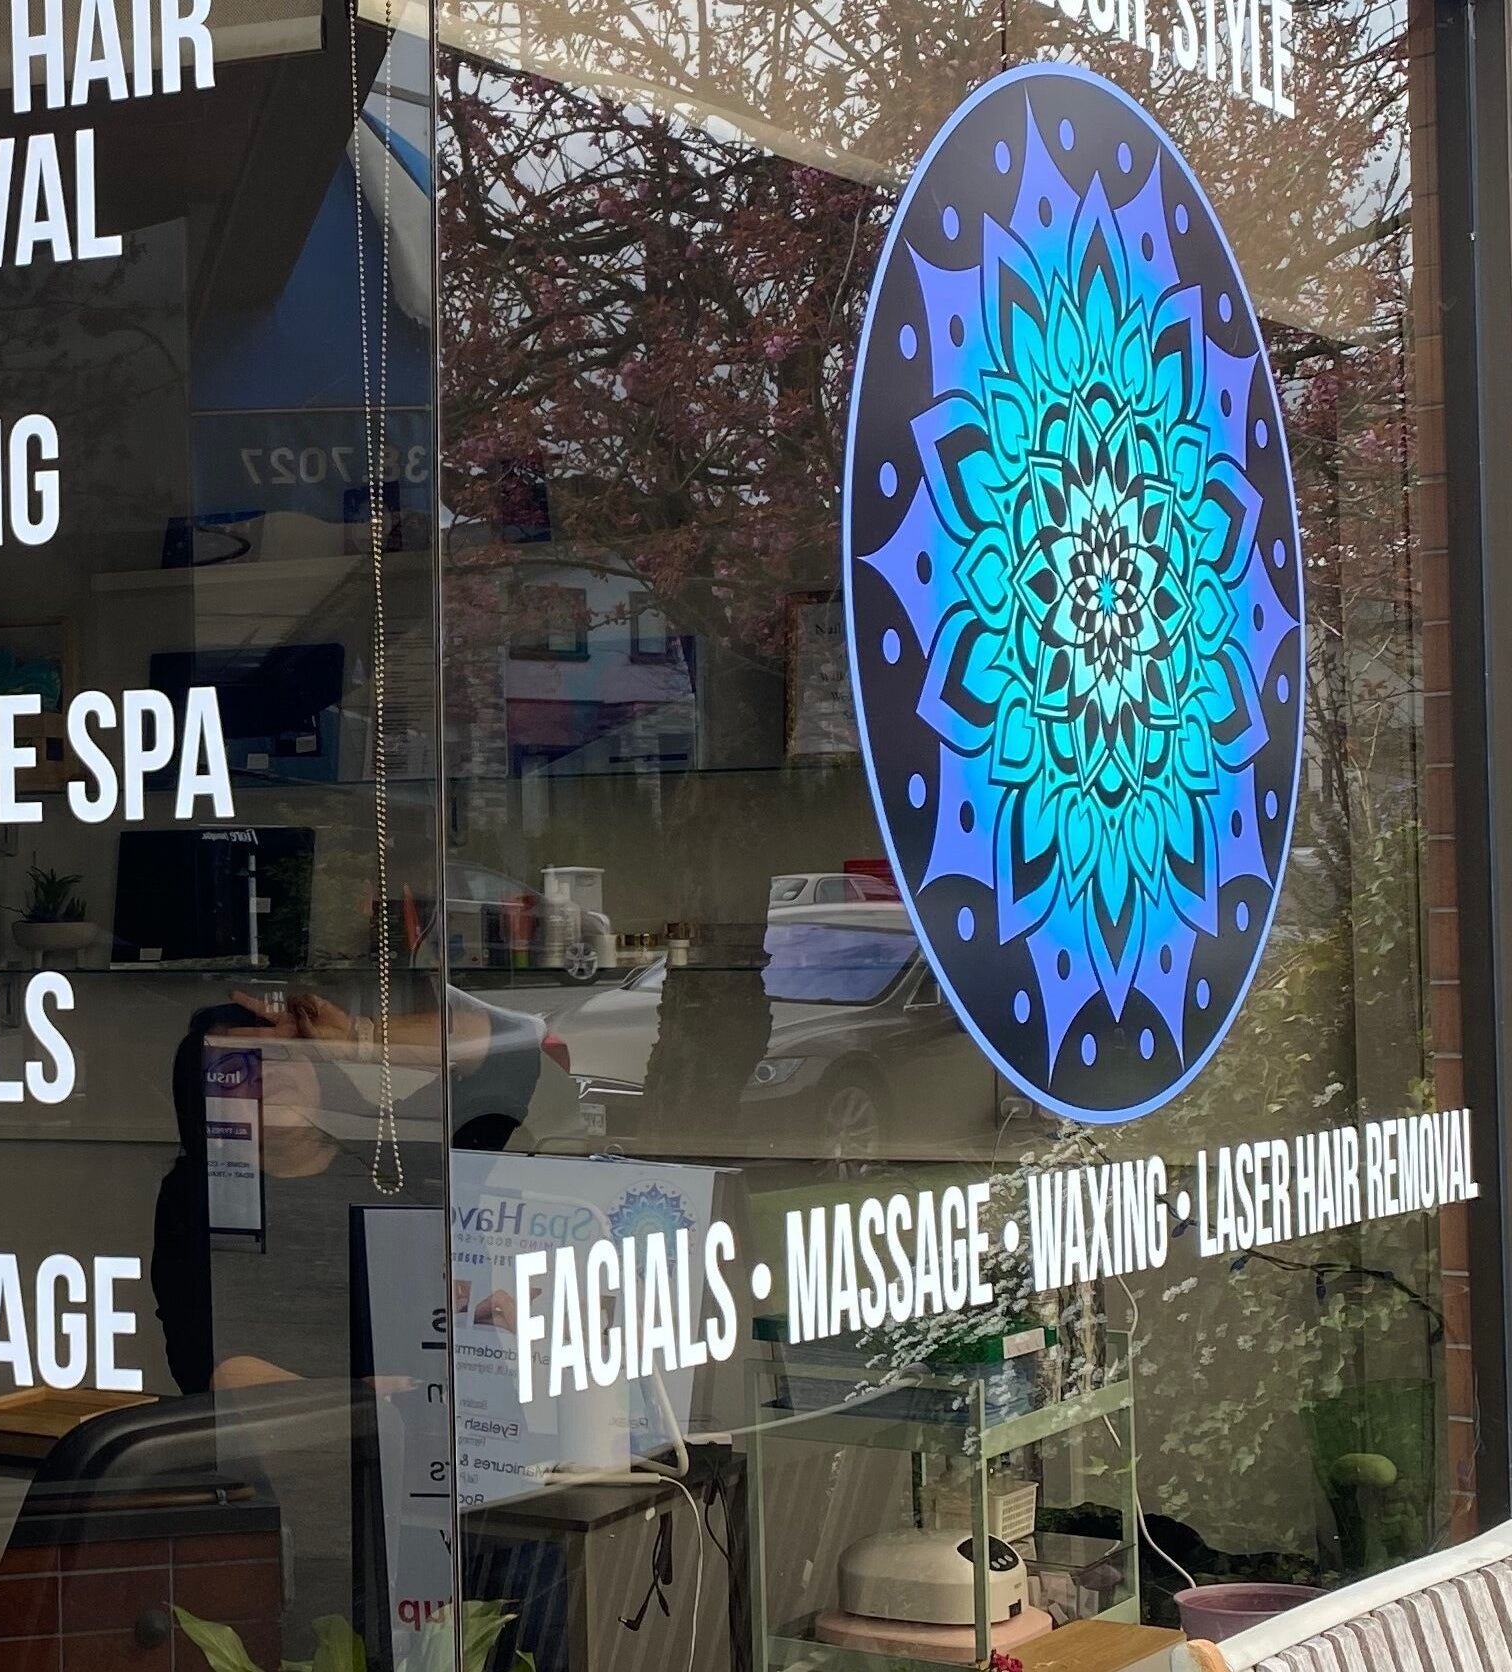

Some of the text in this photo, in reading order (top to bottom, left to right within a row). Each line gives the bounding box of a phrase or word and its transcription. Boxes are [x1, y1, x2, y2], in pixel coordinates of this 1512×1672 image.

[10, 0, 216, 114] HAIR
[1172, 0, 1296, 119] STYLE
[66, 685, 236, 824] SPA
[514, 1107, 1481, 1406] FACIALS MASSAGE WAXING LASER HAIR REMOVAL
